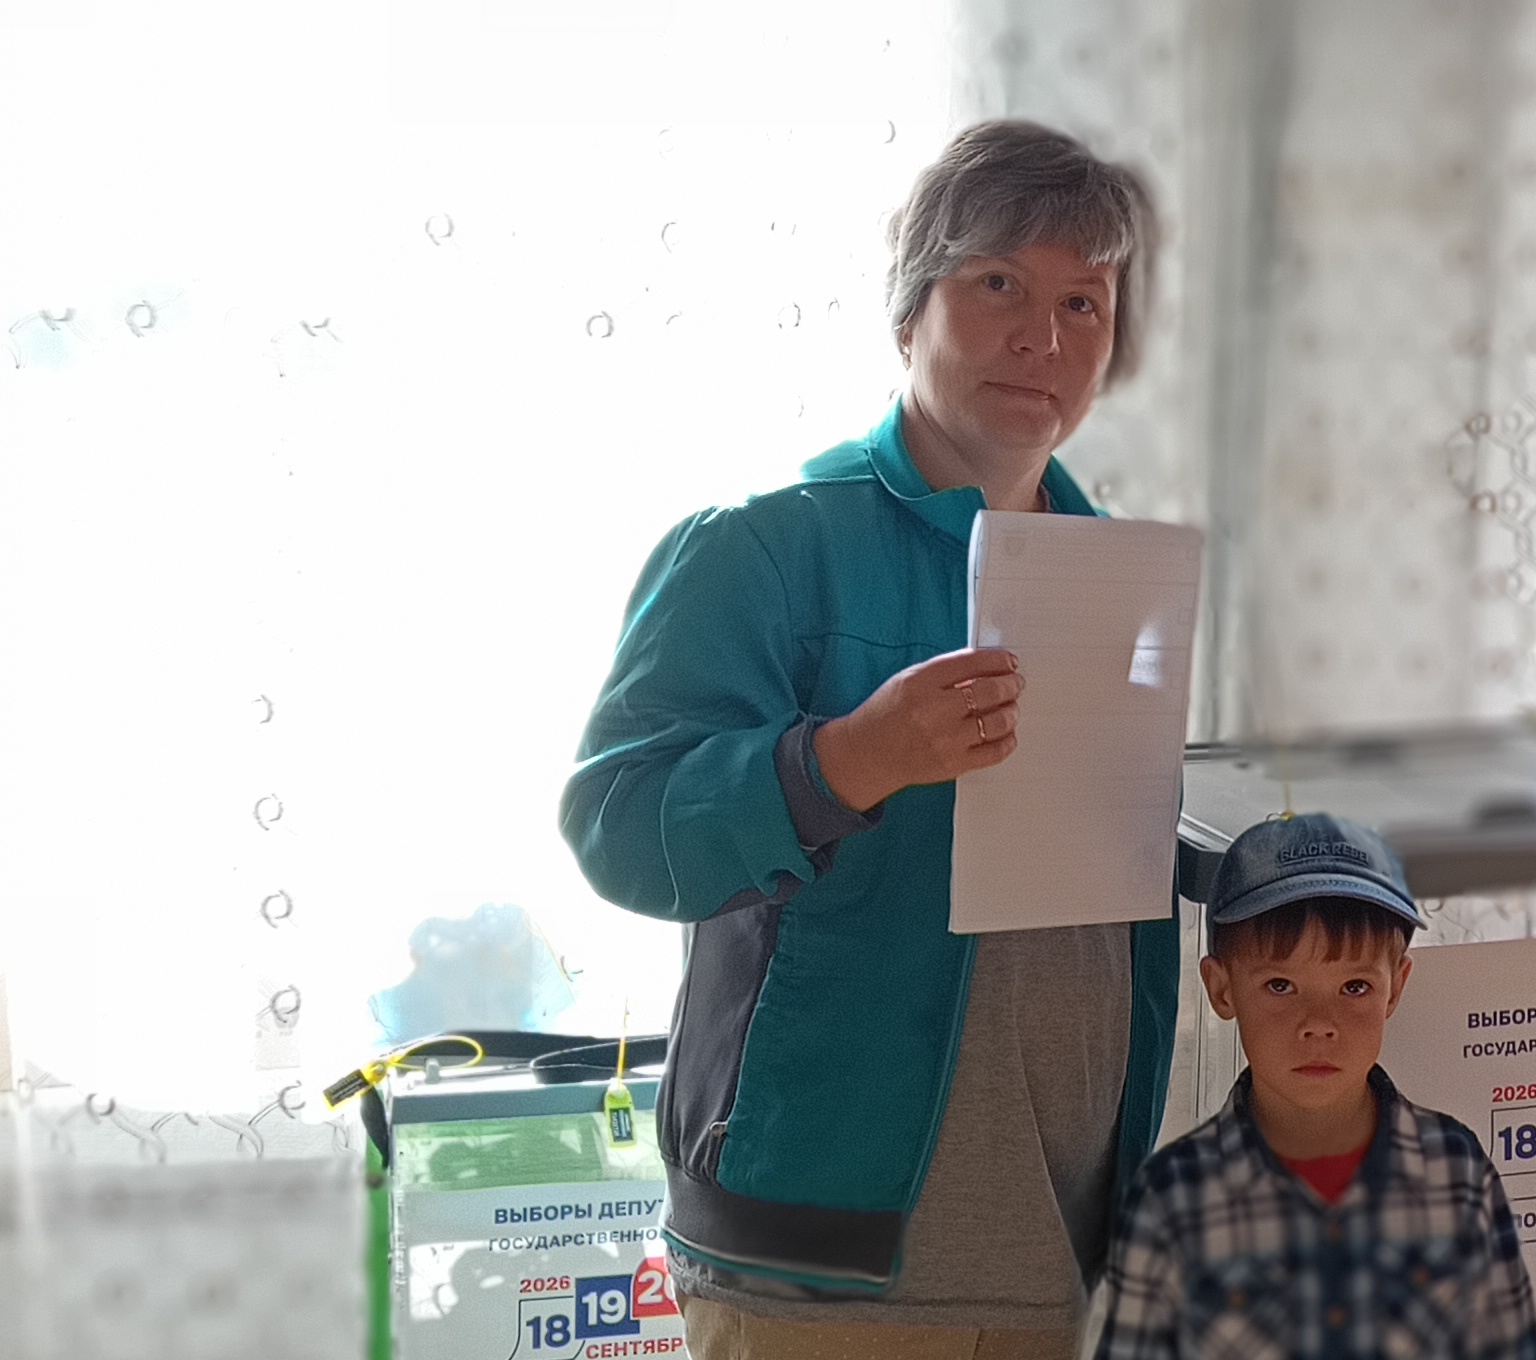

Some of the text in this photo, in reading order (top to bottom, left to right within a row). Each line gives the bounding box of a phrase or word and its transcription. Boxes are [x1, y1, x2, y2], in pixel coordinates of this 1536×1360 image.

[1280, 842, 1330, 862] BLACK
[494, 1199, 664, 1224] ВЫБОРЫ ДЕПУ
[489, 1228, 664, 1251] ГОСУДАРСТВЕННО
[520, 1276, 571, 1293] 2026
[525, 1314, 571, 1350] 18
[581, 1290, 627, 1326] 19
